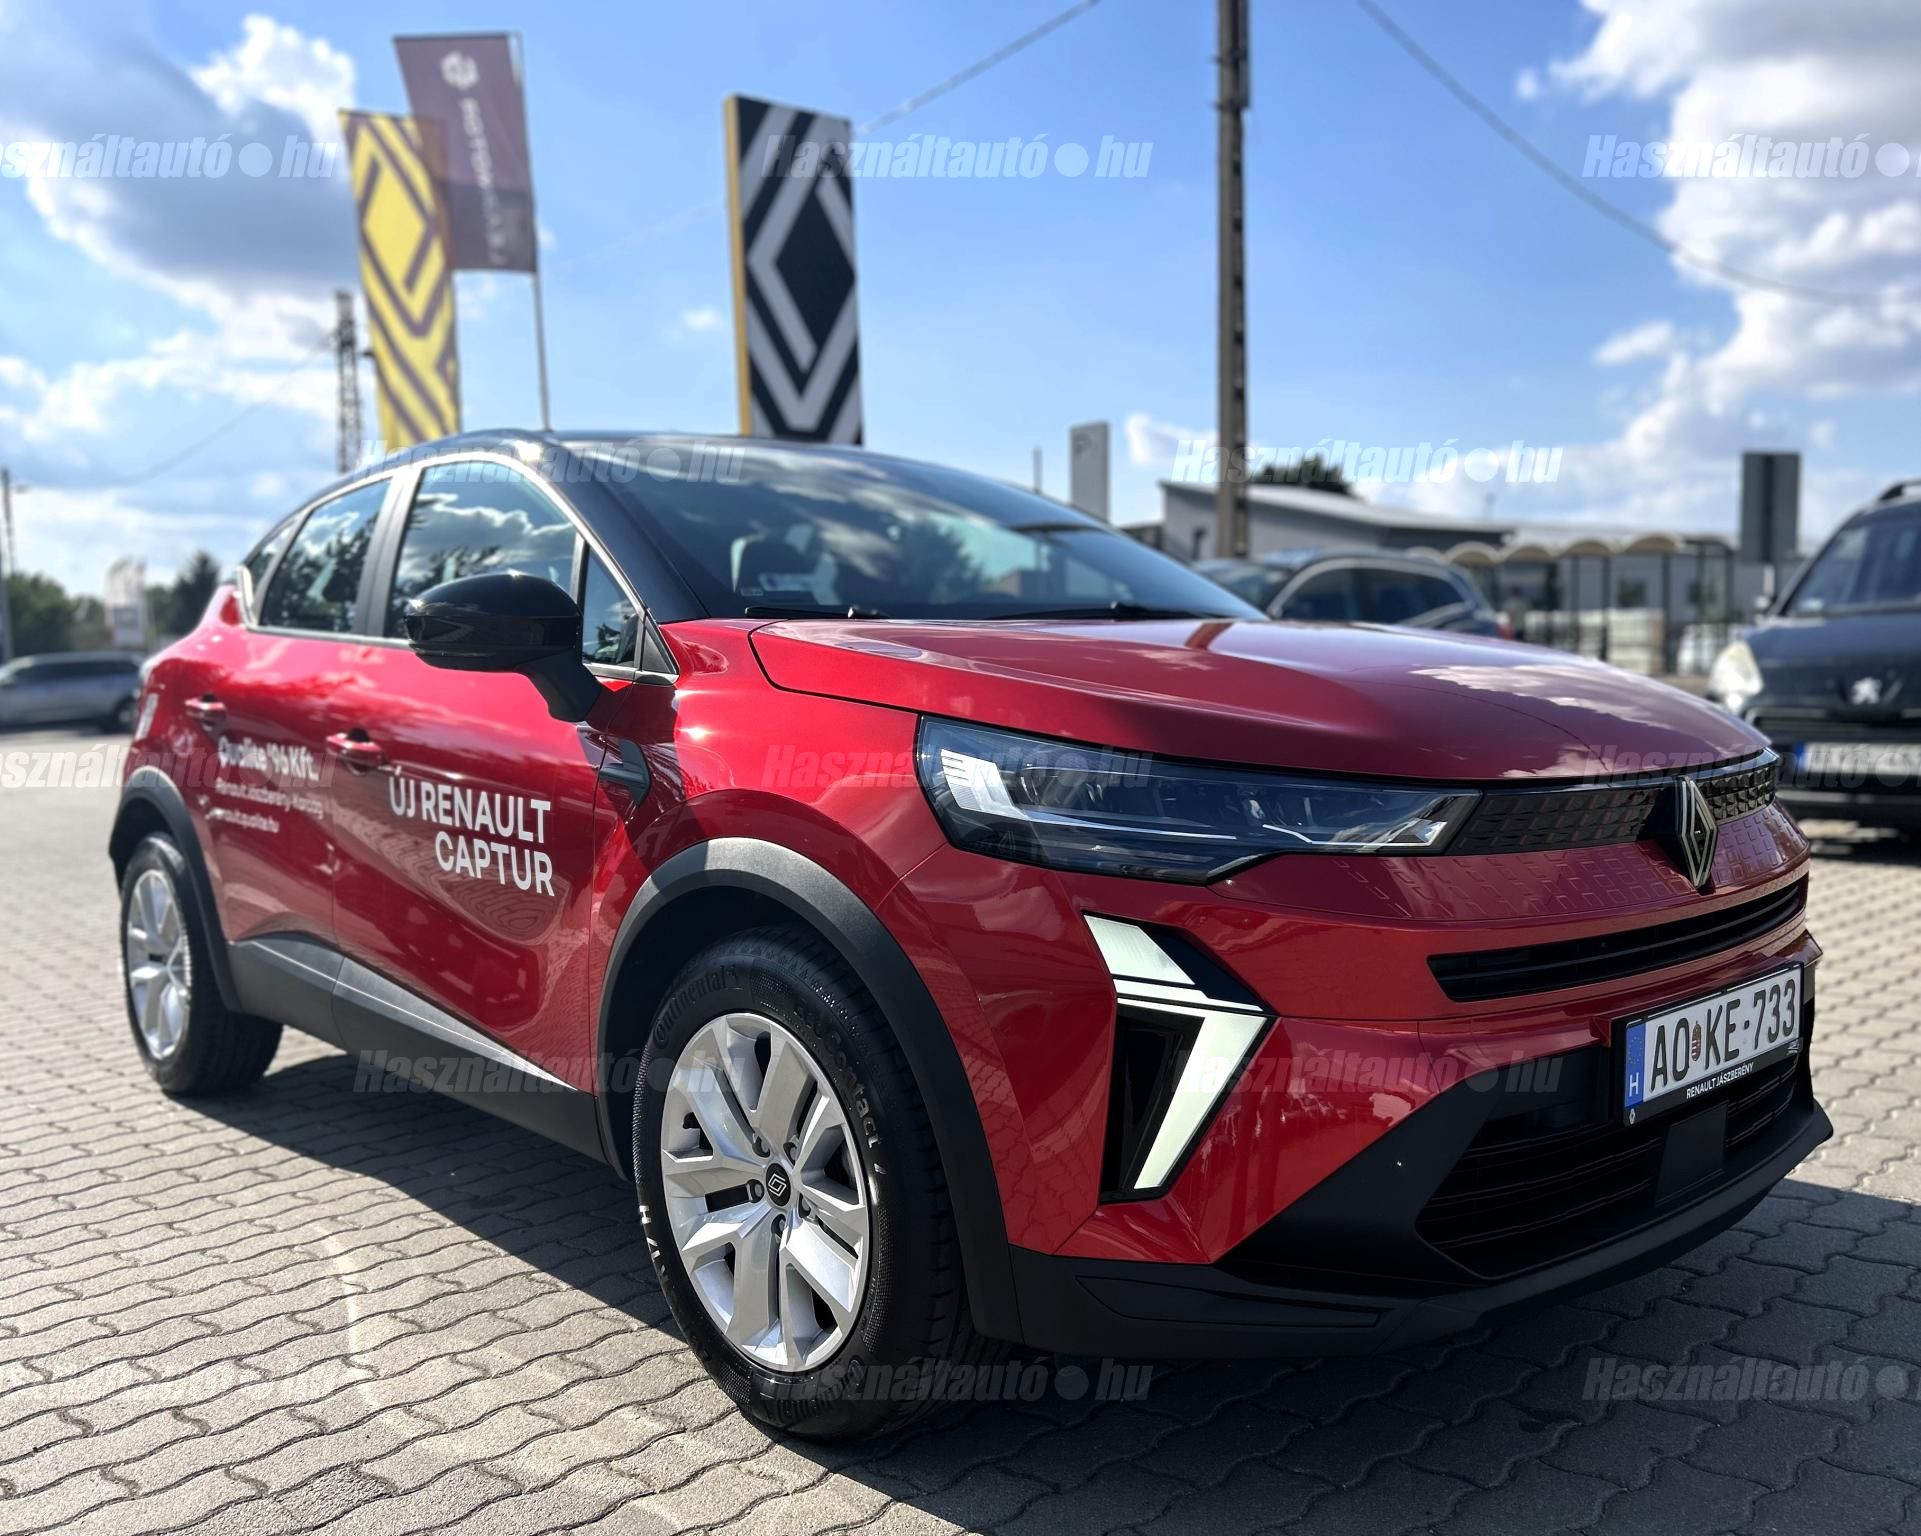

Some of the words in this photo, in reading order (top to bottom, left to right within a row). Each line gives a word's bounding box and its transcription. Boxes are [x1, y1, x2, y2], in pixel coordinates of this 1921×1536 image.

[388, 766, 415, 818] ÚJ
[421, 784, 551, 844] RENAULT
[434, 831, 555, 897] CAPTUR
[1629, 1071, 1640, 1097] H
[1650, 1016, 1690, 1093] AO
[1685, 1078, 1717, 1100] RENAULT
[1715, 1062, 1755, 1088] JÁSZBERÉNY
